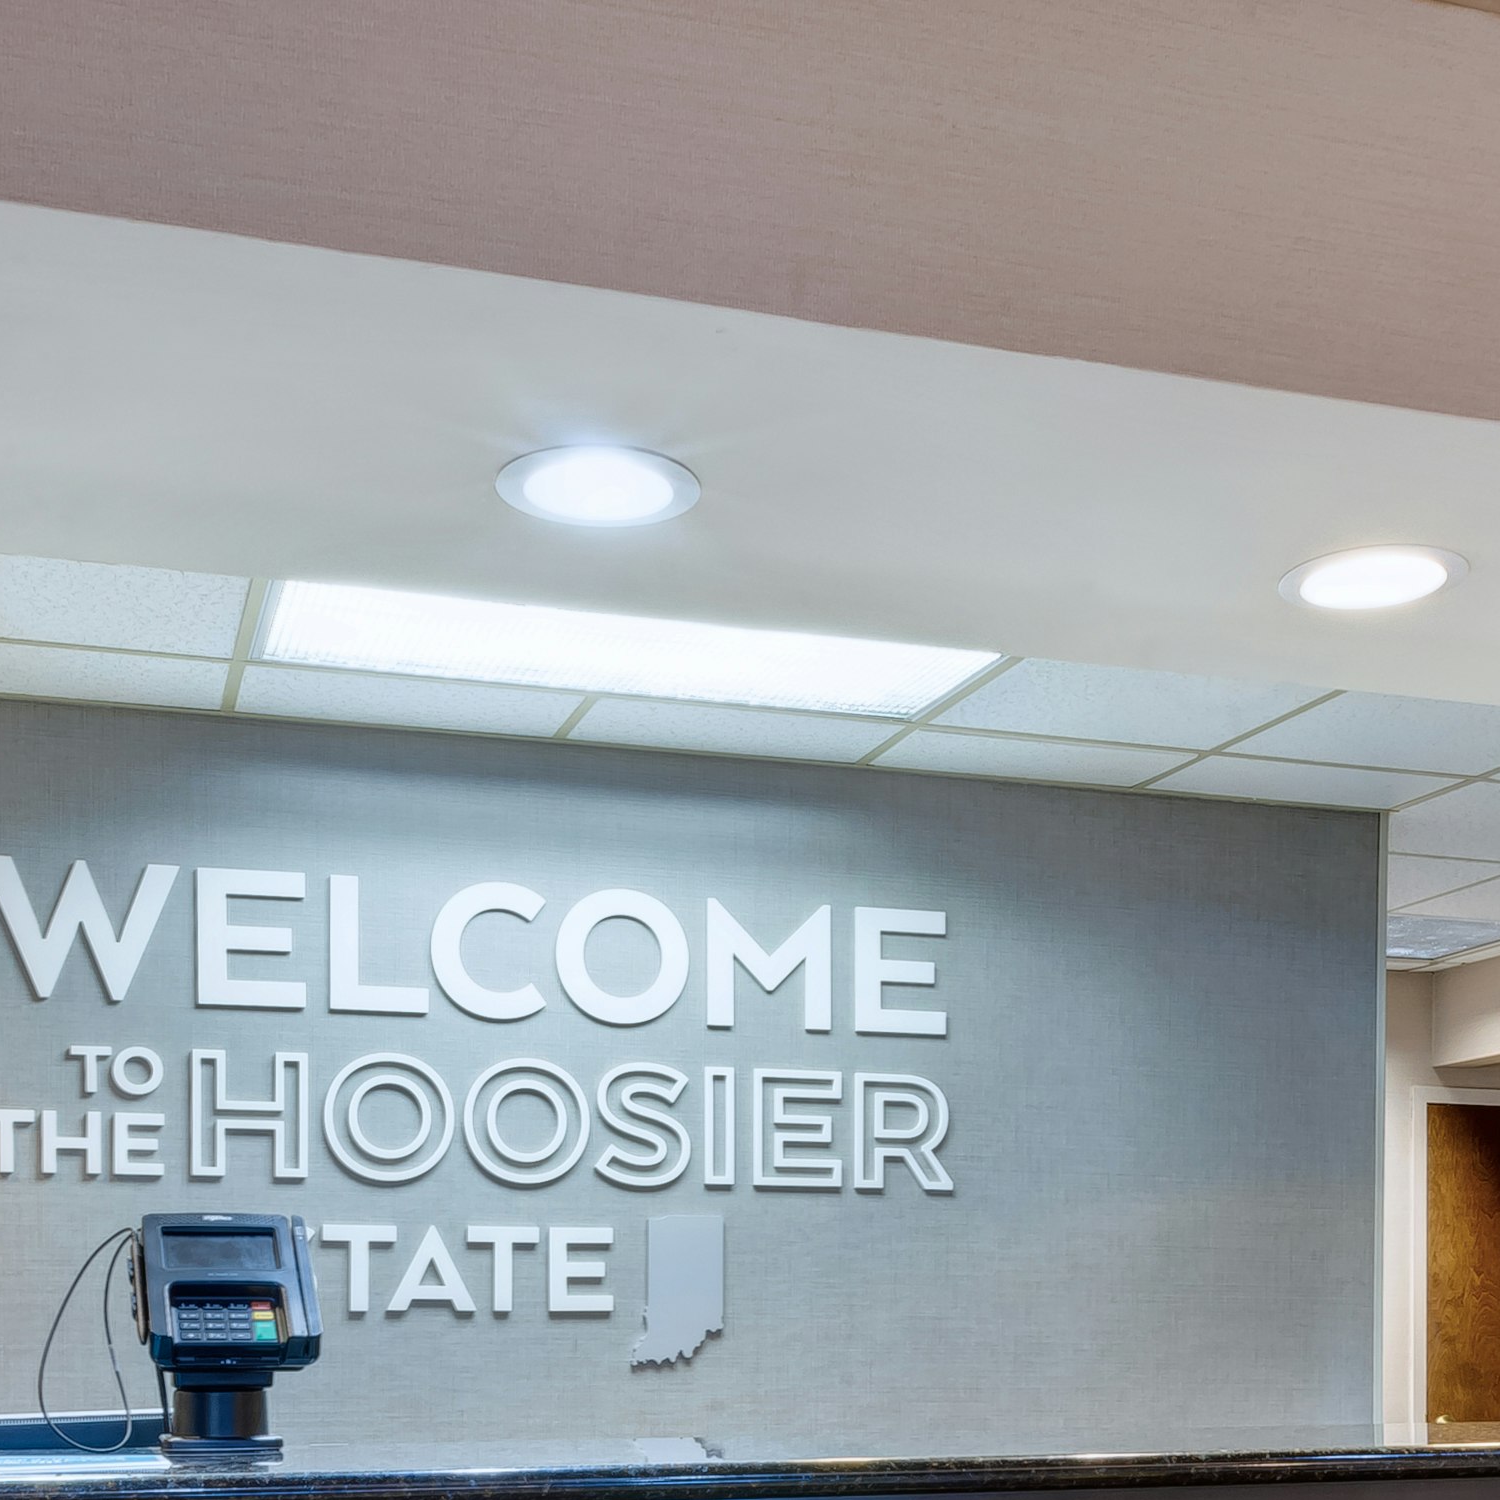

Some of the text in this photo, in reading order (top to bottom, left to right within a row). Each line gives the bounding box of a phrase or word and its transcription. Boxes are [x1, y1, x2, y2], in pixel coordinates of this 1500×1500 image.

[68, 1045, 165, 1097] TO
[189, 1048, 954, 1192] HOOSIER
[306, 1222, 614, 1313] TATE
